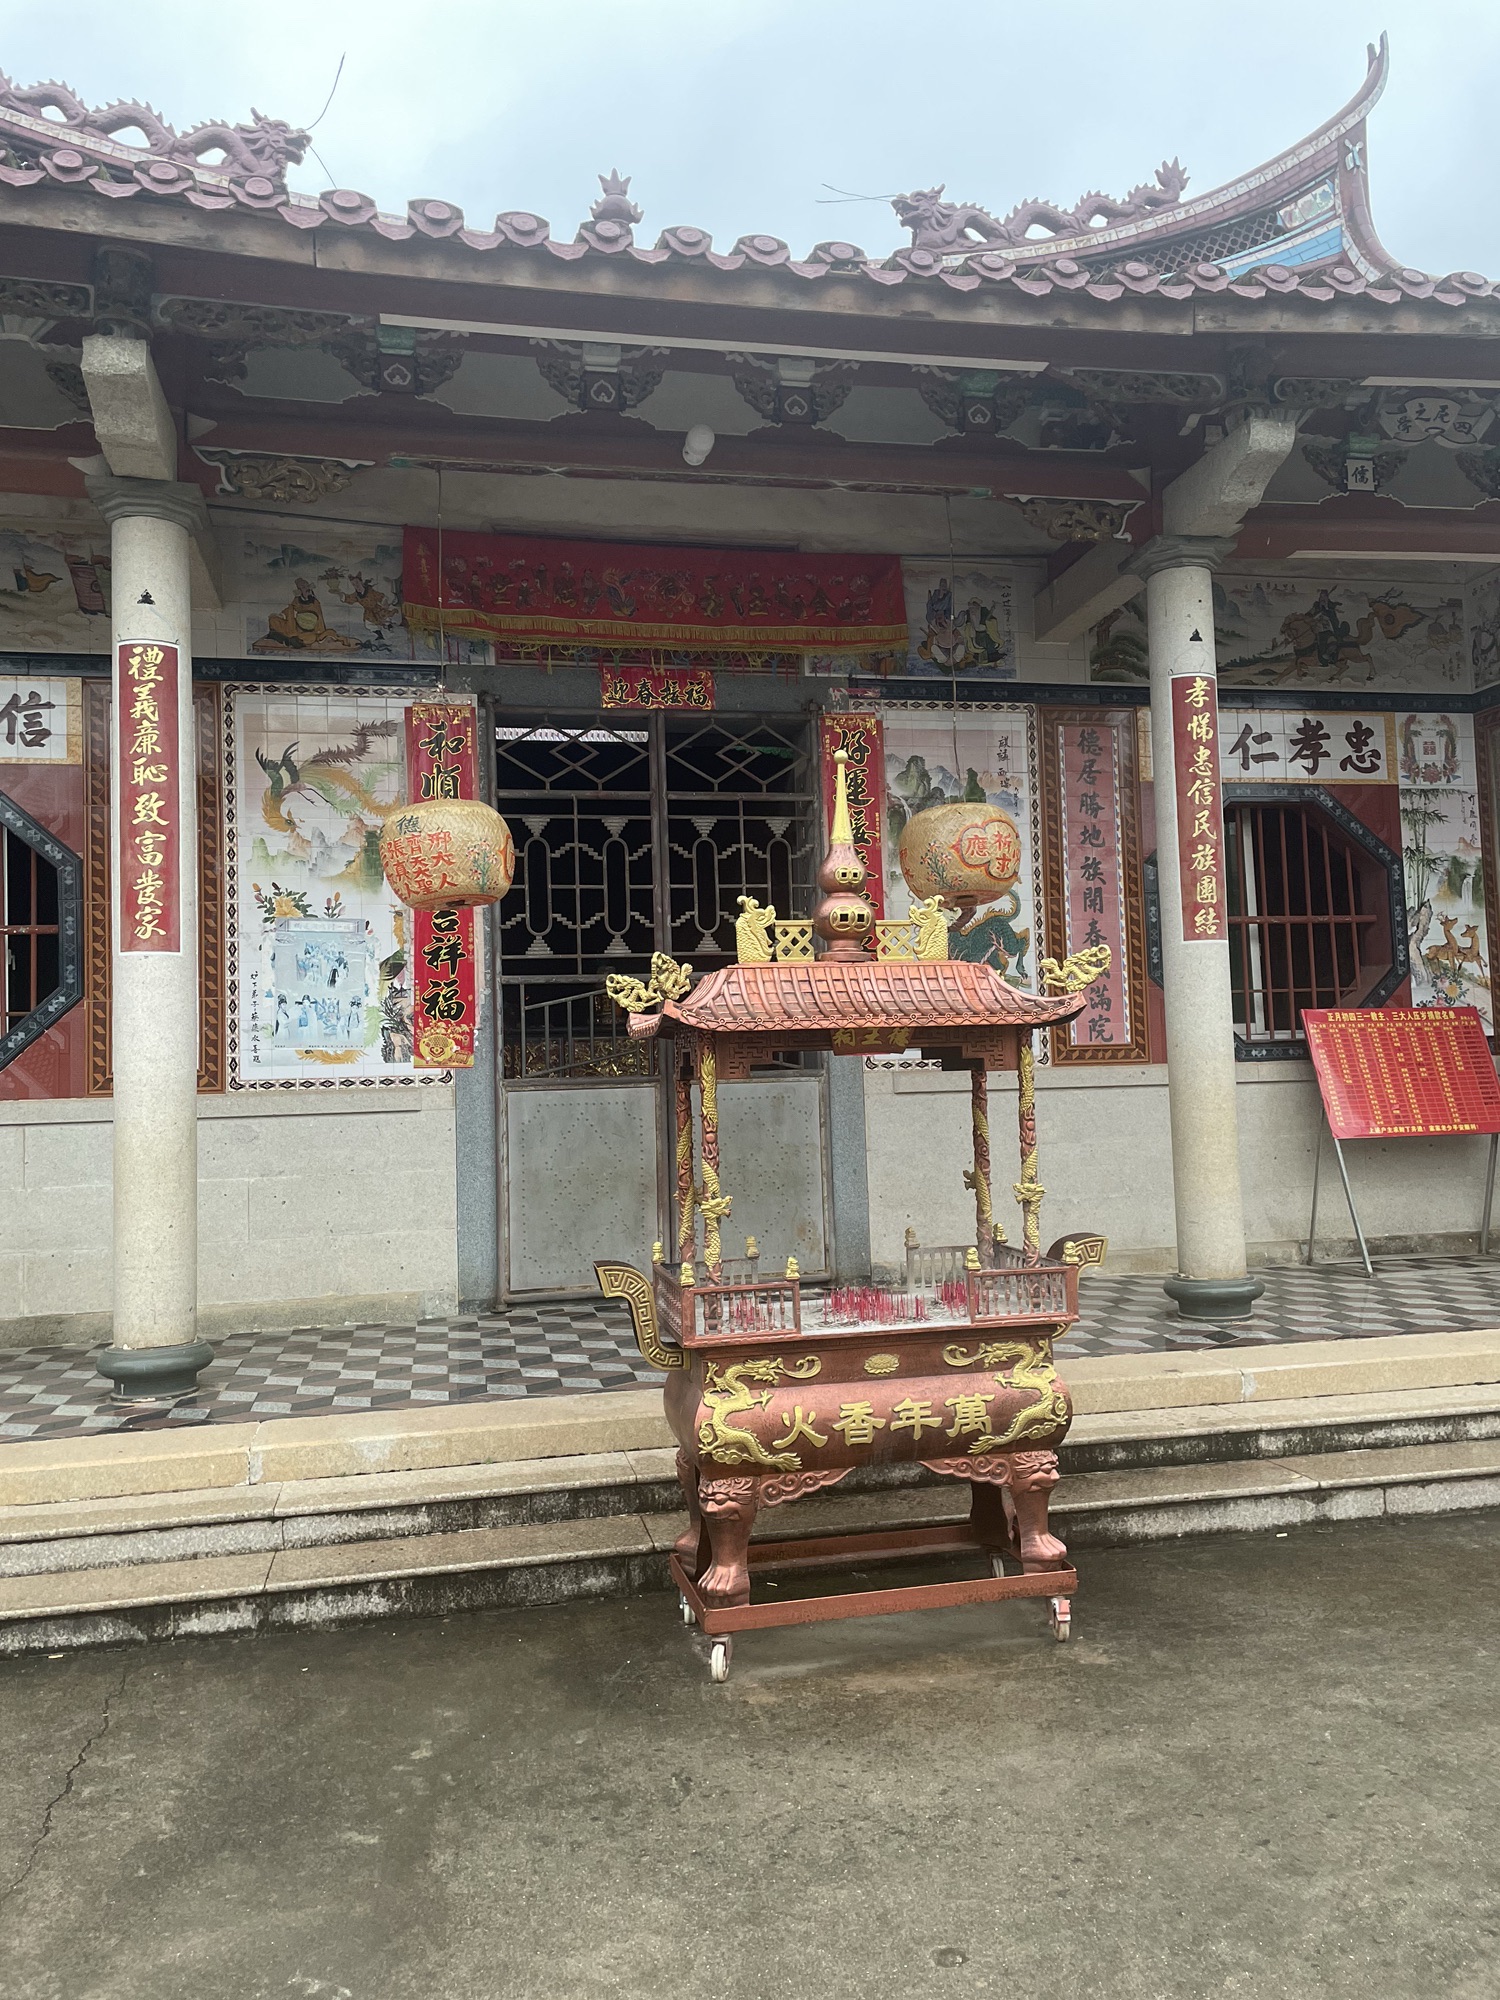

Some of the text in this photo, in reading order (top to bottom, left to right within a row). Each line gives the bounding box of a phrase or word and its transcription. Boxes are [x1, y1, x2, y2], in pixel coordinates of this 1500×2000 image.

[0, 690, 57, 748] 信
[1184, 676, 1221, 935] 孝悌忠信民族團結
[772, 1393, 996, 1449] 萬年香火
